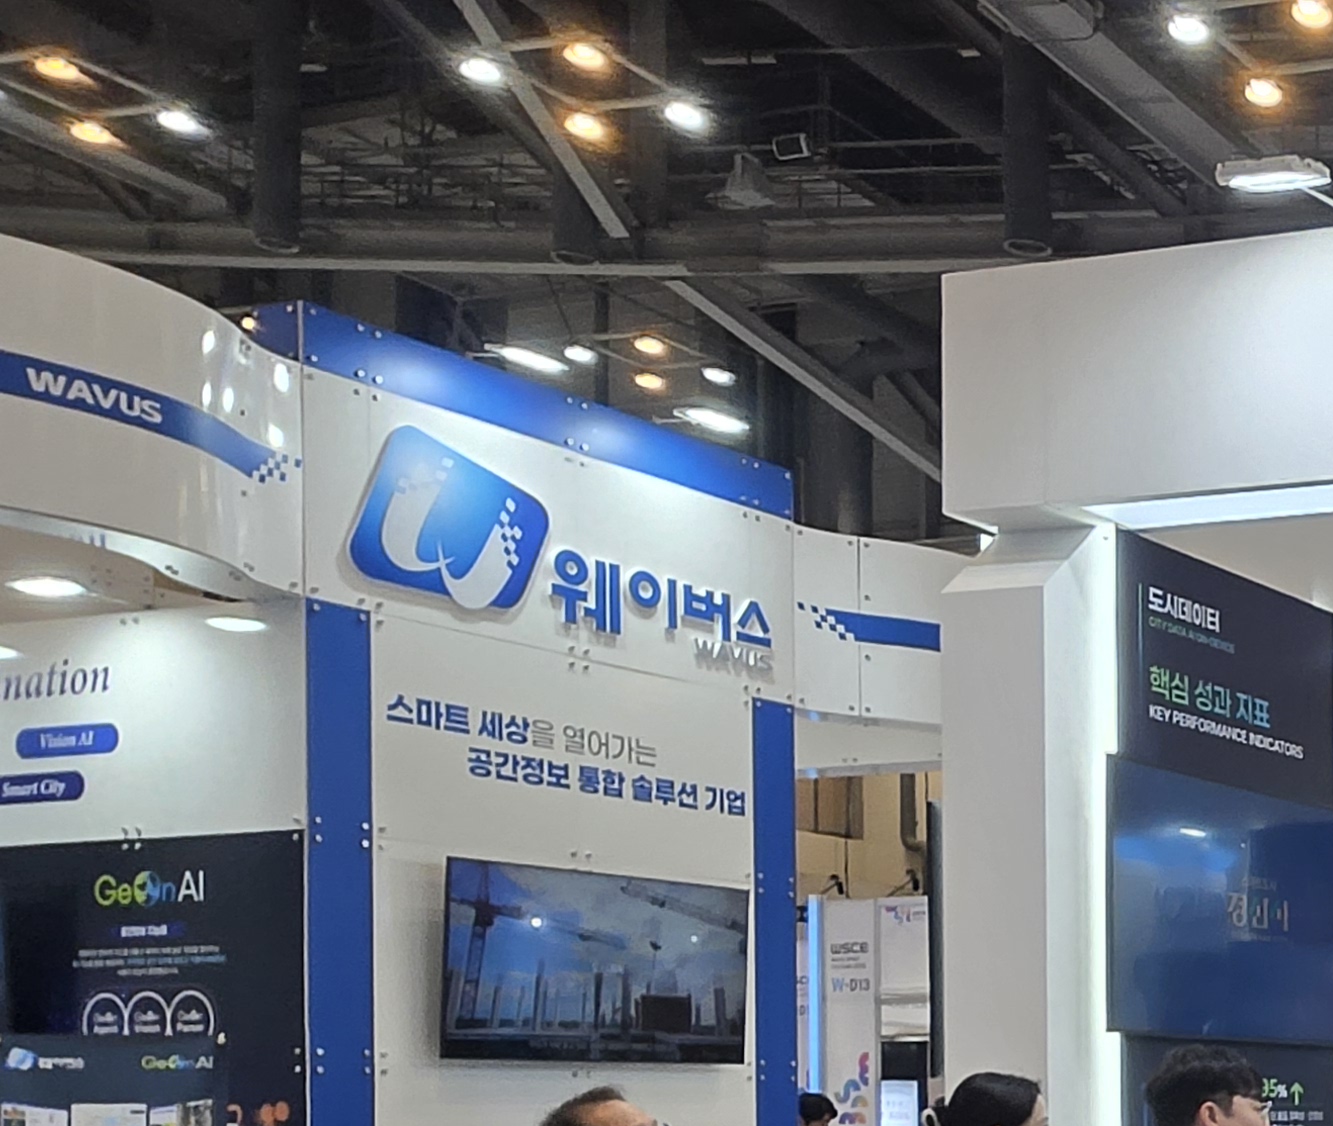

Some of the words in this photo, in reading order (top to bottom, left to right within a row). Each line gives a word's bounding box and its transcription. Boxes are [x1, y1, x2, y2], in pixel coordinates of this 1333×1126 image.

[26, 367, 162, 424] WAVUS
[551, 550, 772, 648] 웨이버스
[1148, 586, 1221, 633] 도시데이터
[694, 637, 773, 669] WAVUS
[1150, 665, 1189, 706] 핵심
[1194, 680, 1232, 718] 성과
[1236, 692, 1270, 729] 지표
[78, 730, 94, 746] AI
[386, 693, 471, 735] 스마트
[478, 710, 556, 750] 세상을
[562, 724, 658, 768] 열어가는
[1149, 704, 1172, 723] KEY
[1172, 710, 1248, 744] PERFORMANCE
[1249, 731, 1304, 759] INDICATORS
[2, 781, 38, 797] Smart
[40, 779, 66, 797] City
[467, 747, 571, 790] 공간정보
[577, 764, 625, 799] 통합
[631, 773, 699, 810] 솔루션
[704, 785, 747, 817] 기업
[177, 870, 204, 902] AI
